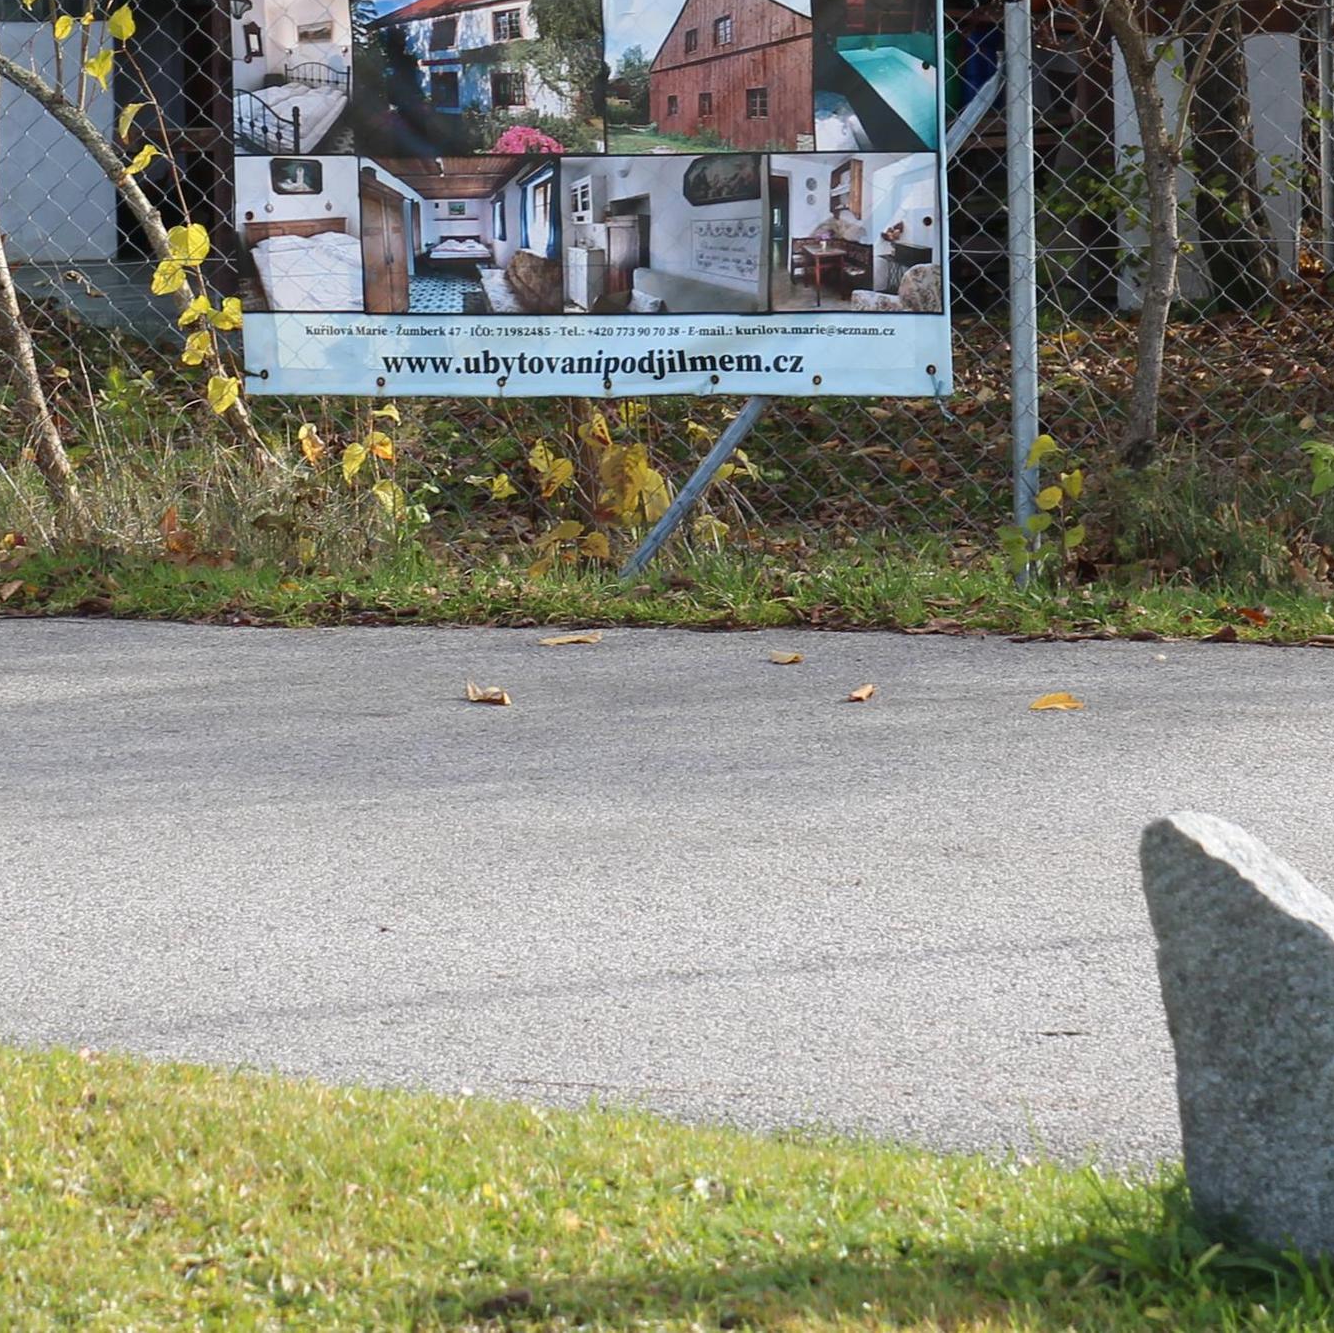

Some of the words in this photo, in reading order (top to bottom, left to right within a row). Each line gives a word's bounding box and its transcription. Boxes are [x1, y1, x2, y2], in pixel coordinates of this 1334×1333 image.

[305, 324, 354, 337] Kuřilová
[355, 325, 388, 337] Marie
[395, 323, 447, 337] Žumberk
[448, 326, 461, 337] 47
[470, 324, 495, 337] IČO:
[497, 327, 551, 337] 71982485
[587, 326, 614, 337] +420
[617, 326, 636, 337] 773
[637, 326, 651, 337] 90
[652, 326, 666, 337] 70
[667, 326, 680, 337] 38
[735, 324, 896, 337] kurilova.marie@seznam.cz
[381, 349, 804, 381] www.ubytovanipodjilmem.cz
